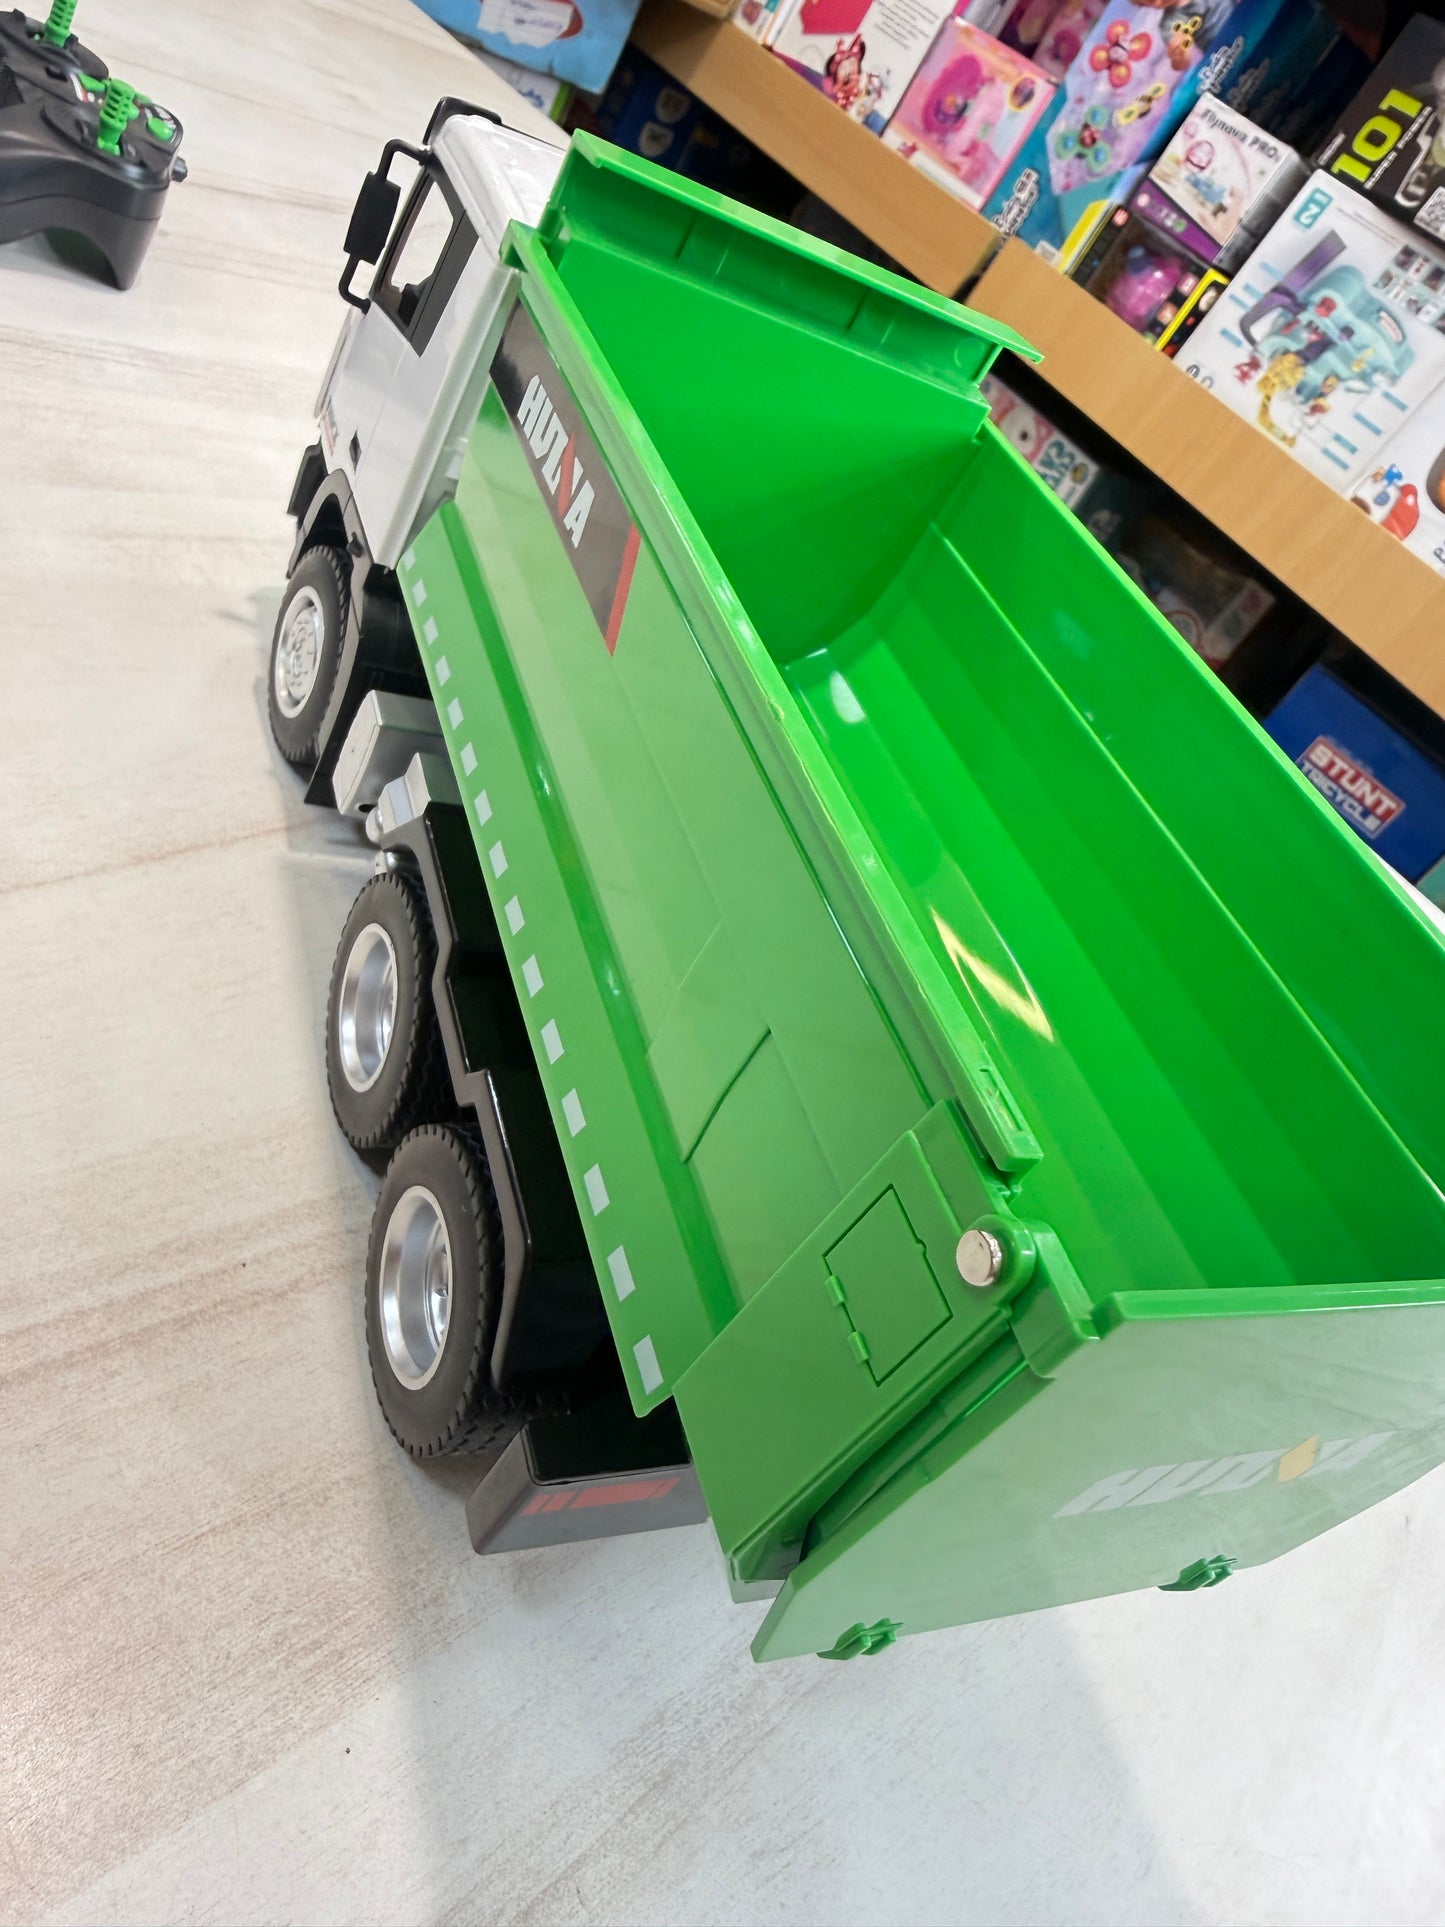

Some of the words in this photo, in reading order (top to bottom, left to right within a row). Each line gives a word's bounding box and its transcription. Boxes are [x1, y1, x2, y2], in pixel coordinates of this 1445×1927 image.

[1250, 135, 1279, 158] PRO
[1331, 88, 1424, 184] 101
[1301, 761, 1381, 832] TRICYCLE
[1308, 743, 1397, 816] STUNT
